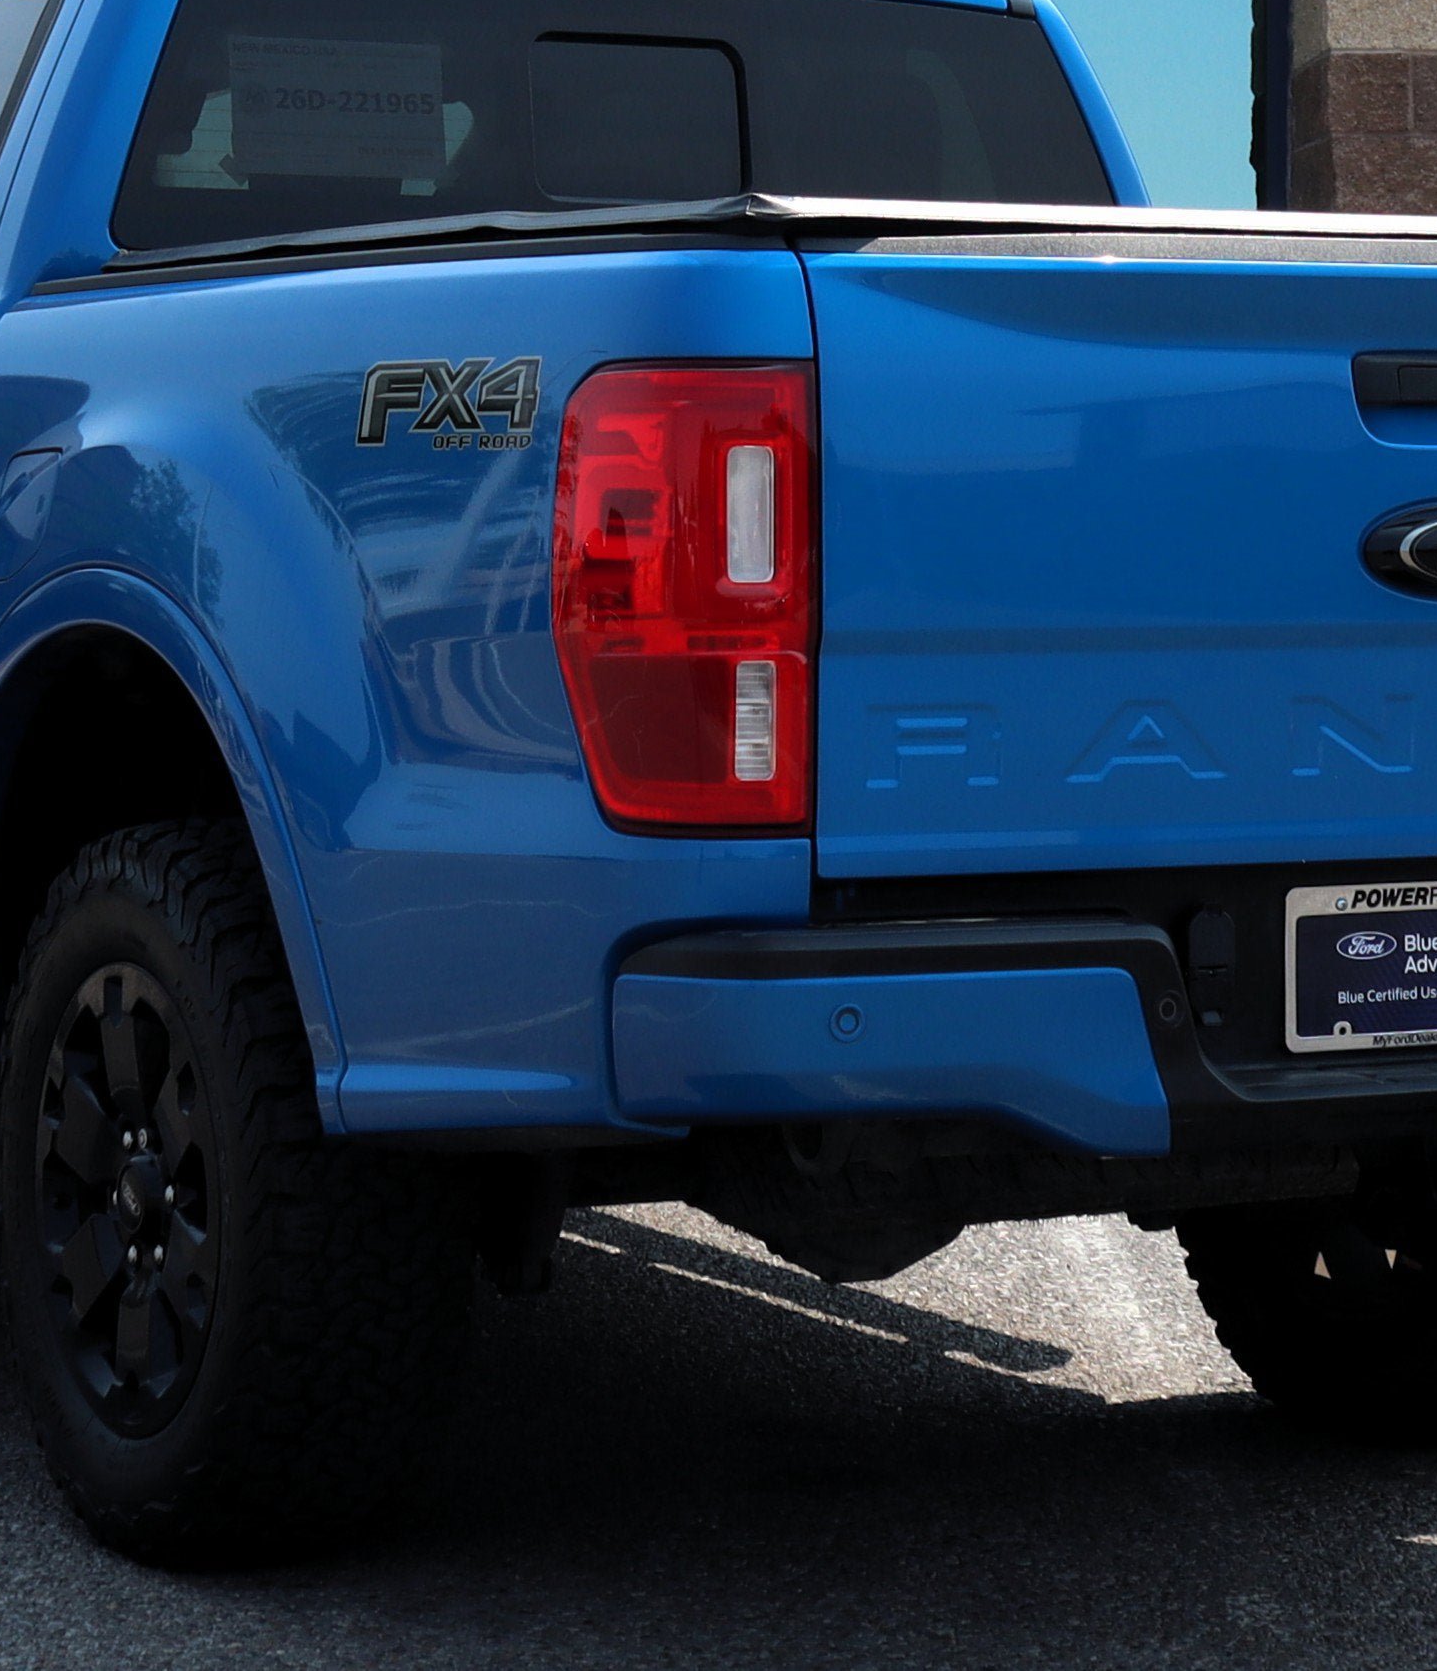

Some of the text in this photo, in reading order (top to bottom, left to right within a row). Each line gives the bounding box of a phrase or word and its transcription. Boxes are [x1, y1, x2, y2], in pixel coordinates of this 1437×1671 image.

[275, 86, 436, 116] 26D-221965
[356, 355, 543, 447] FX4
[433, 433, 532, 450] OFF ROAD
[1347, 935, 1384, 955] Ford
[1338, 990, 1364, 1004] Blue
[1367, 986, 1417, 1002] Certified
